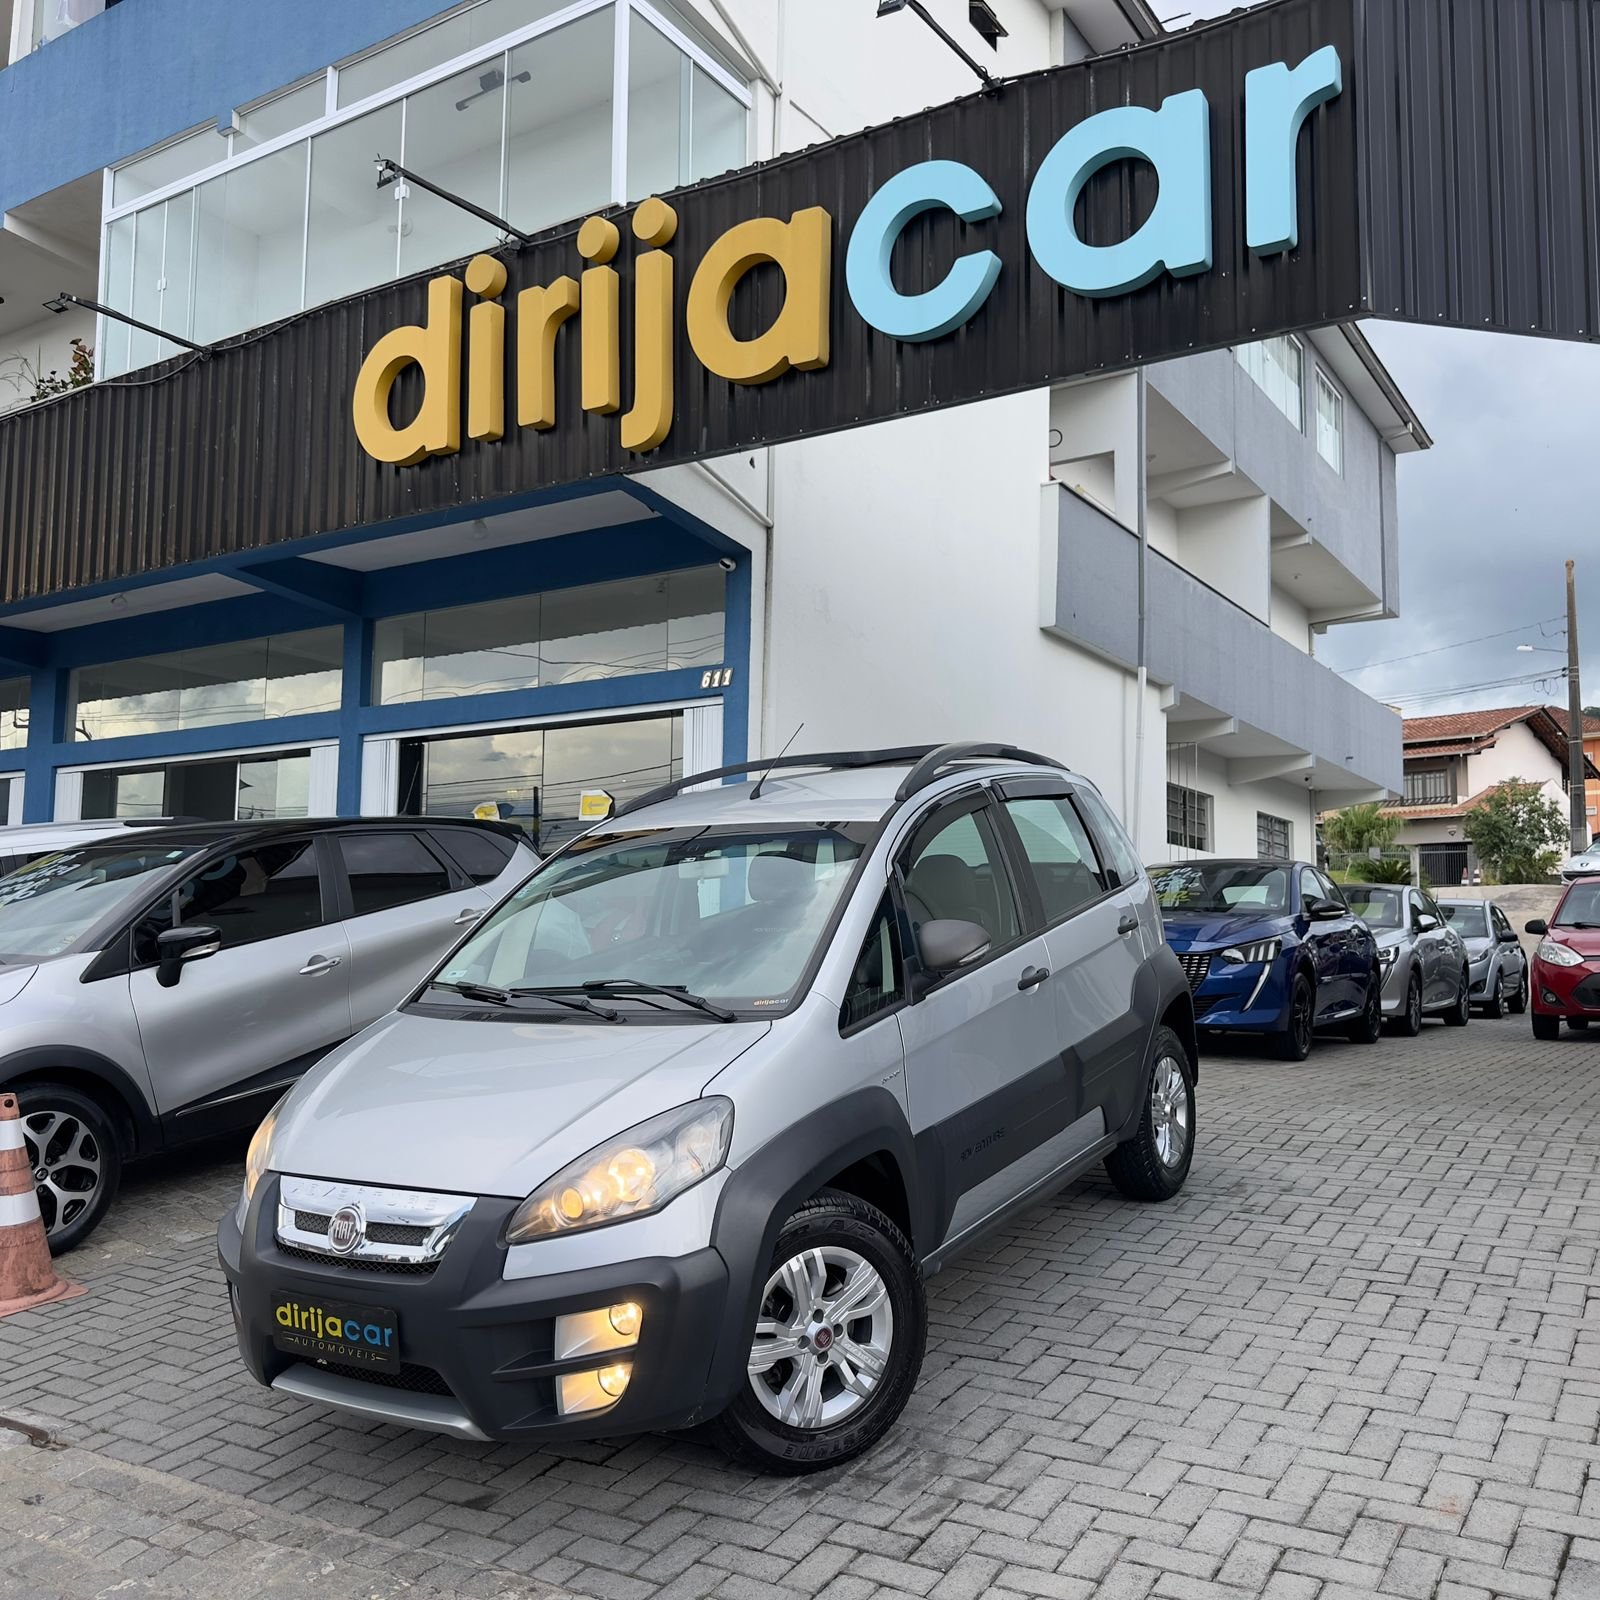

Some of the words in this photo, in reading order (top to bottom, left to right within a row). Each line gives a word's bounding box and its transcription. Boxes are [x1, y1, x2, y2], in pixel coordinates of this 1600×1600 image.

[353, 45, 1342, 466] dirijacar
[701, 669, 733, 688] 611
[334, 1220, 354, 1241] FIAT
[276, 1302, 393, 1347] dirijacar
[294, 1337, 376, 1361] AUTOMÓVEIS
